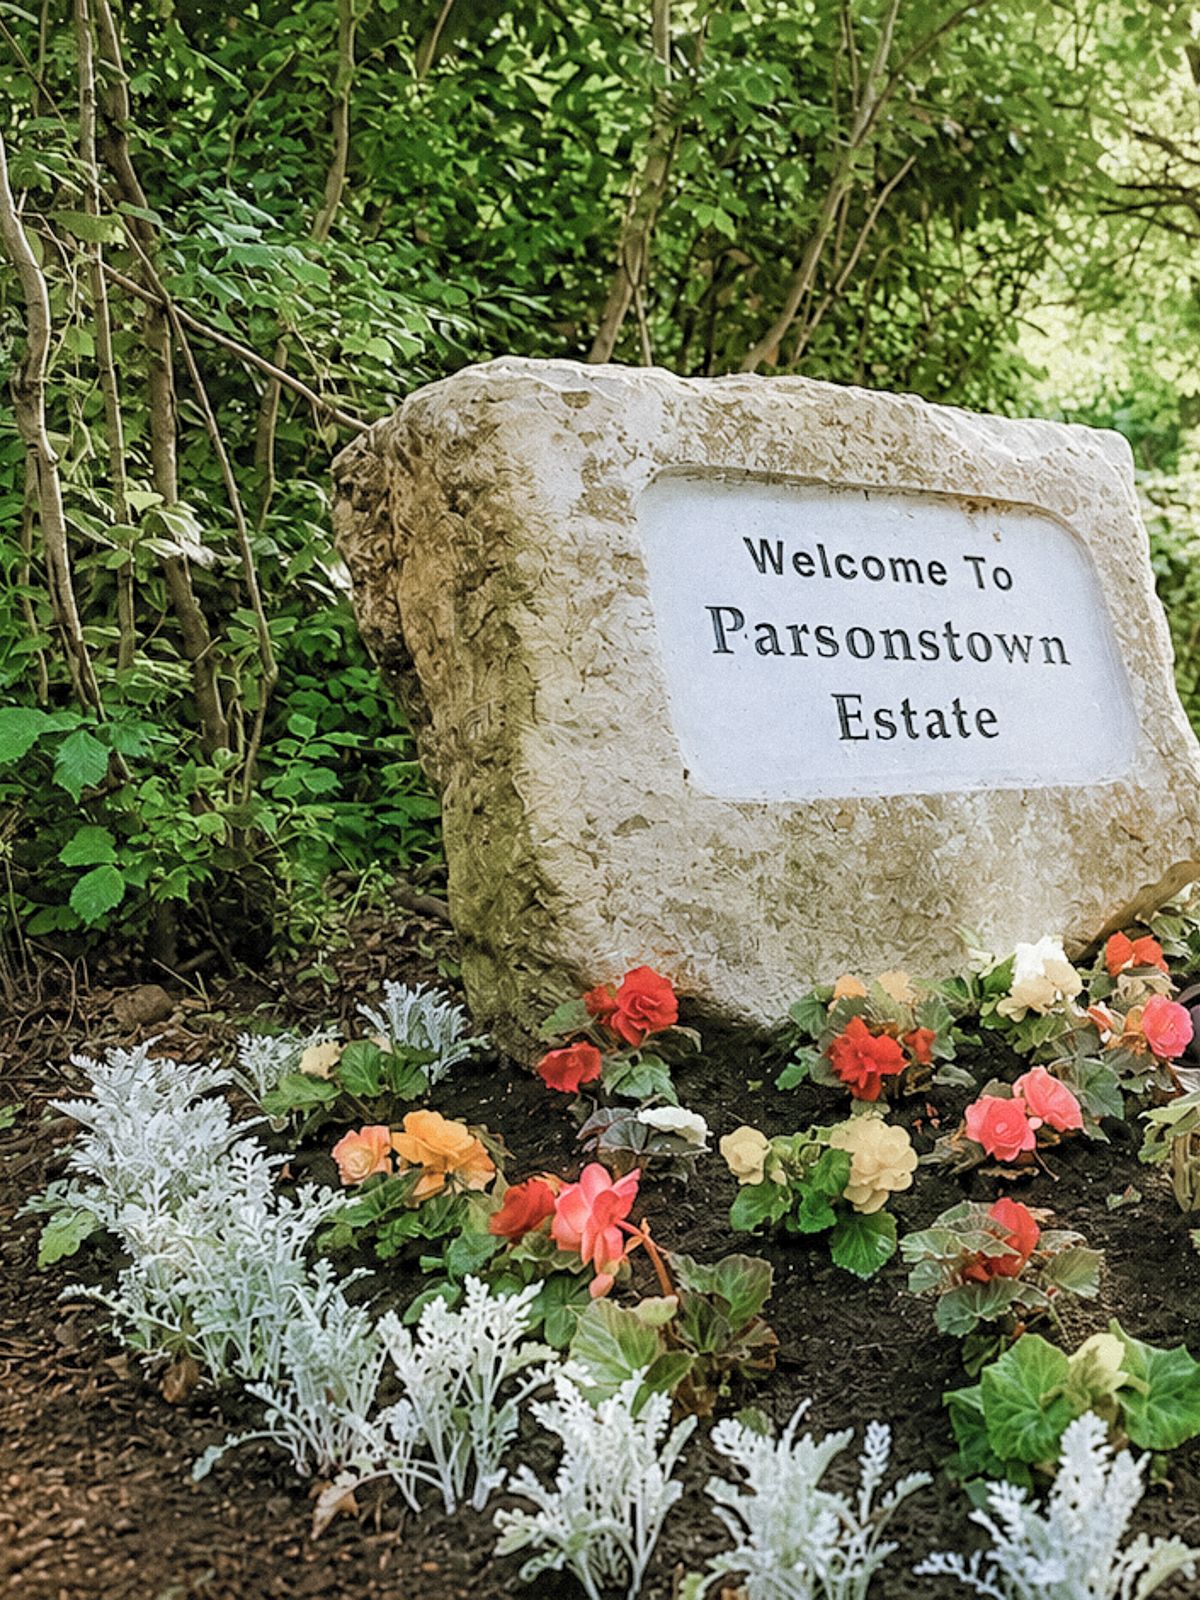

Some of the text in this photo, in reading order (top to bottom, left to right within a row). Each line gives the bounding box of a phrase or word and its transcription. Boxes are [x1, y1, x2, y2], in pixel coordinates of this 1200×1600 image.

[743, 536, 1013, 591] Welcome To
[704, 605, 1072, 666] Parsonstown
[831, 693, 1000, 741] Estate
